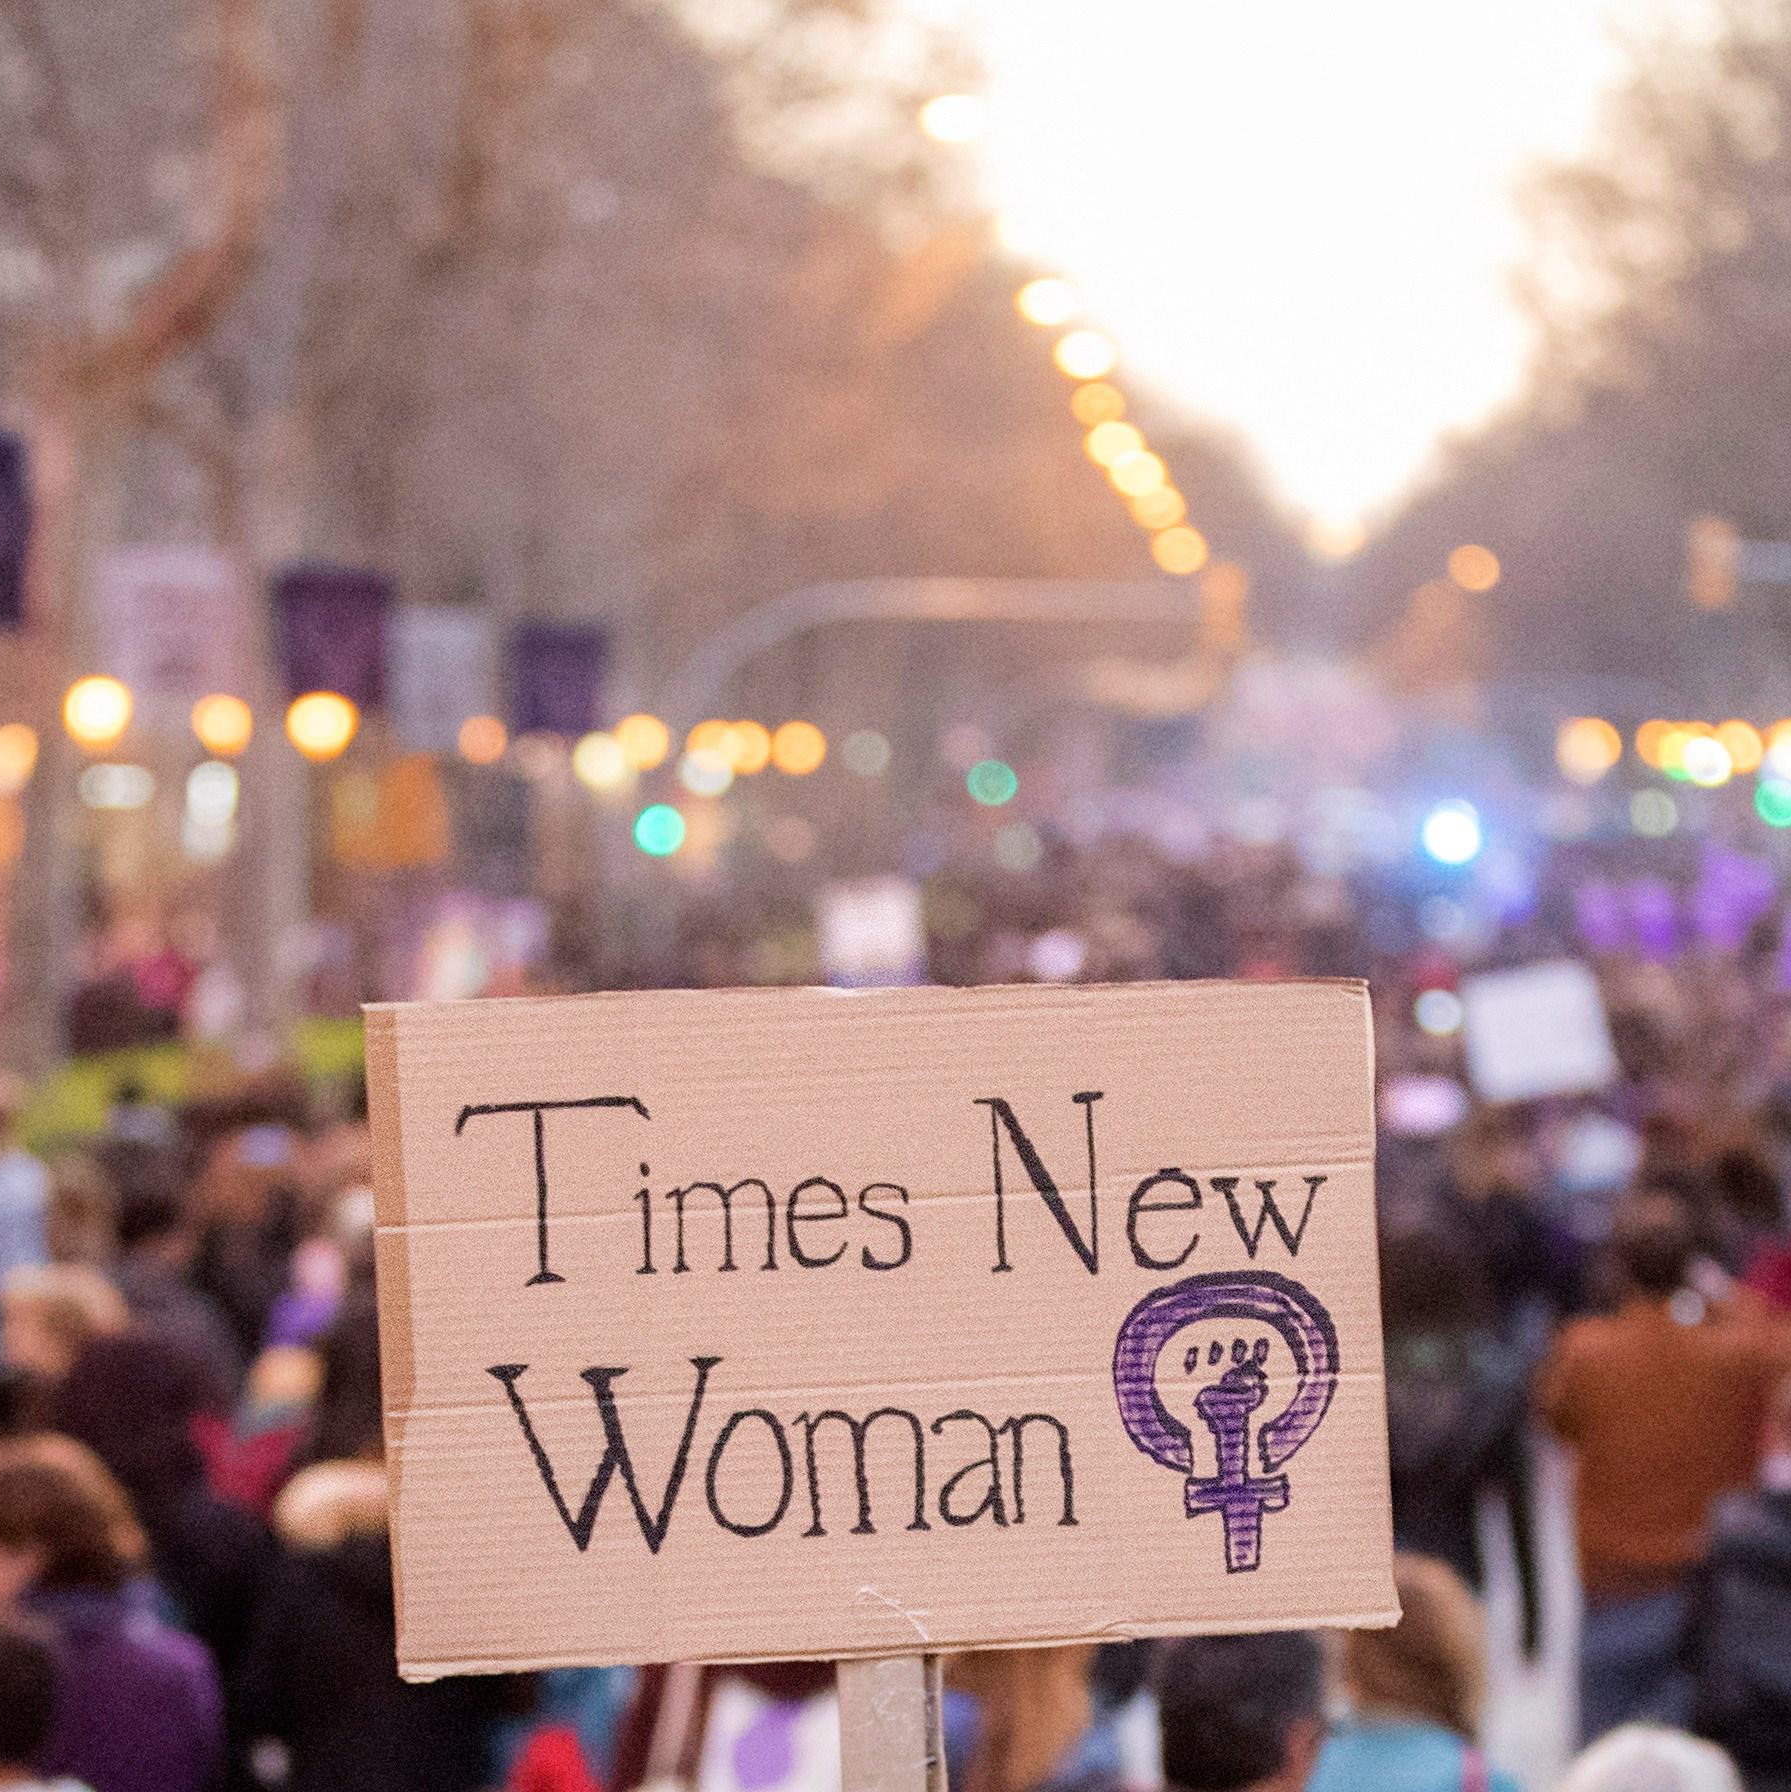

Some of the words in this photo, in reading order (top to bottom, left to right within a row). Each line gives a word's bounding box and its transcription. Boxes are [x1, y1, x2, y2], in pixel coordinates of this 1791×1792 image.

[454, 1094, 916, 1287] Times
[972, 1091, 1328, 1276] New
[486, 1355, 1080, 1554] Woman
